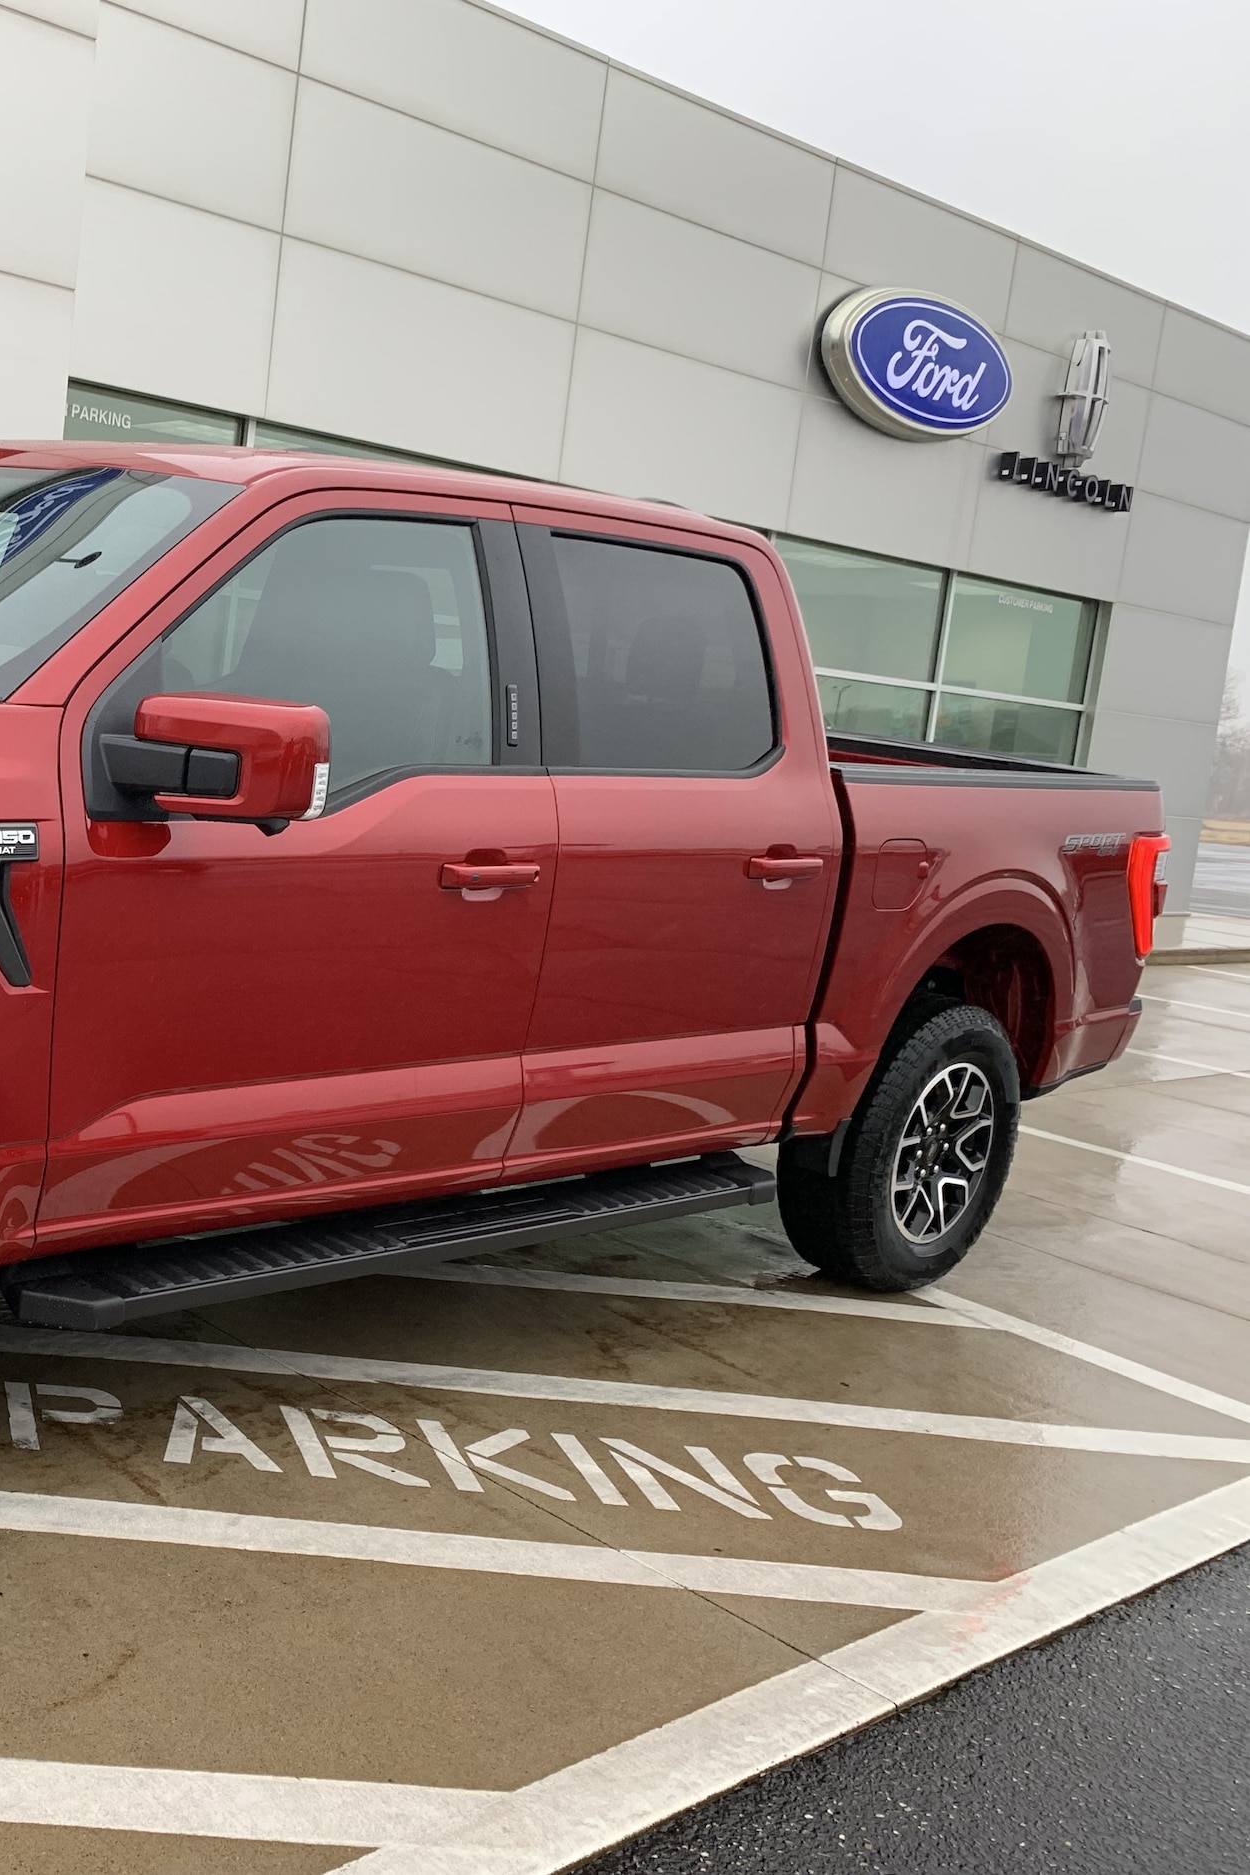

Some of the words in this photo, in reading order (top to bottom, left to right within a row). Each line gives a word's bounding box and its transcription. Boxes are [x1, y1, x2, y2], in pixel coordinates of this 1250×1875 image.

[886, 319, 987, 411] Ford
[71, 403, 131, 430] PARKING
[999, 451, 1134, 512] LINCOLN
[1062, 832, 1127, 854] SPORT
[4, 1380, 903, 1531] PARKING
